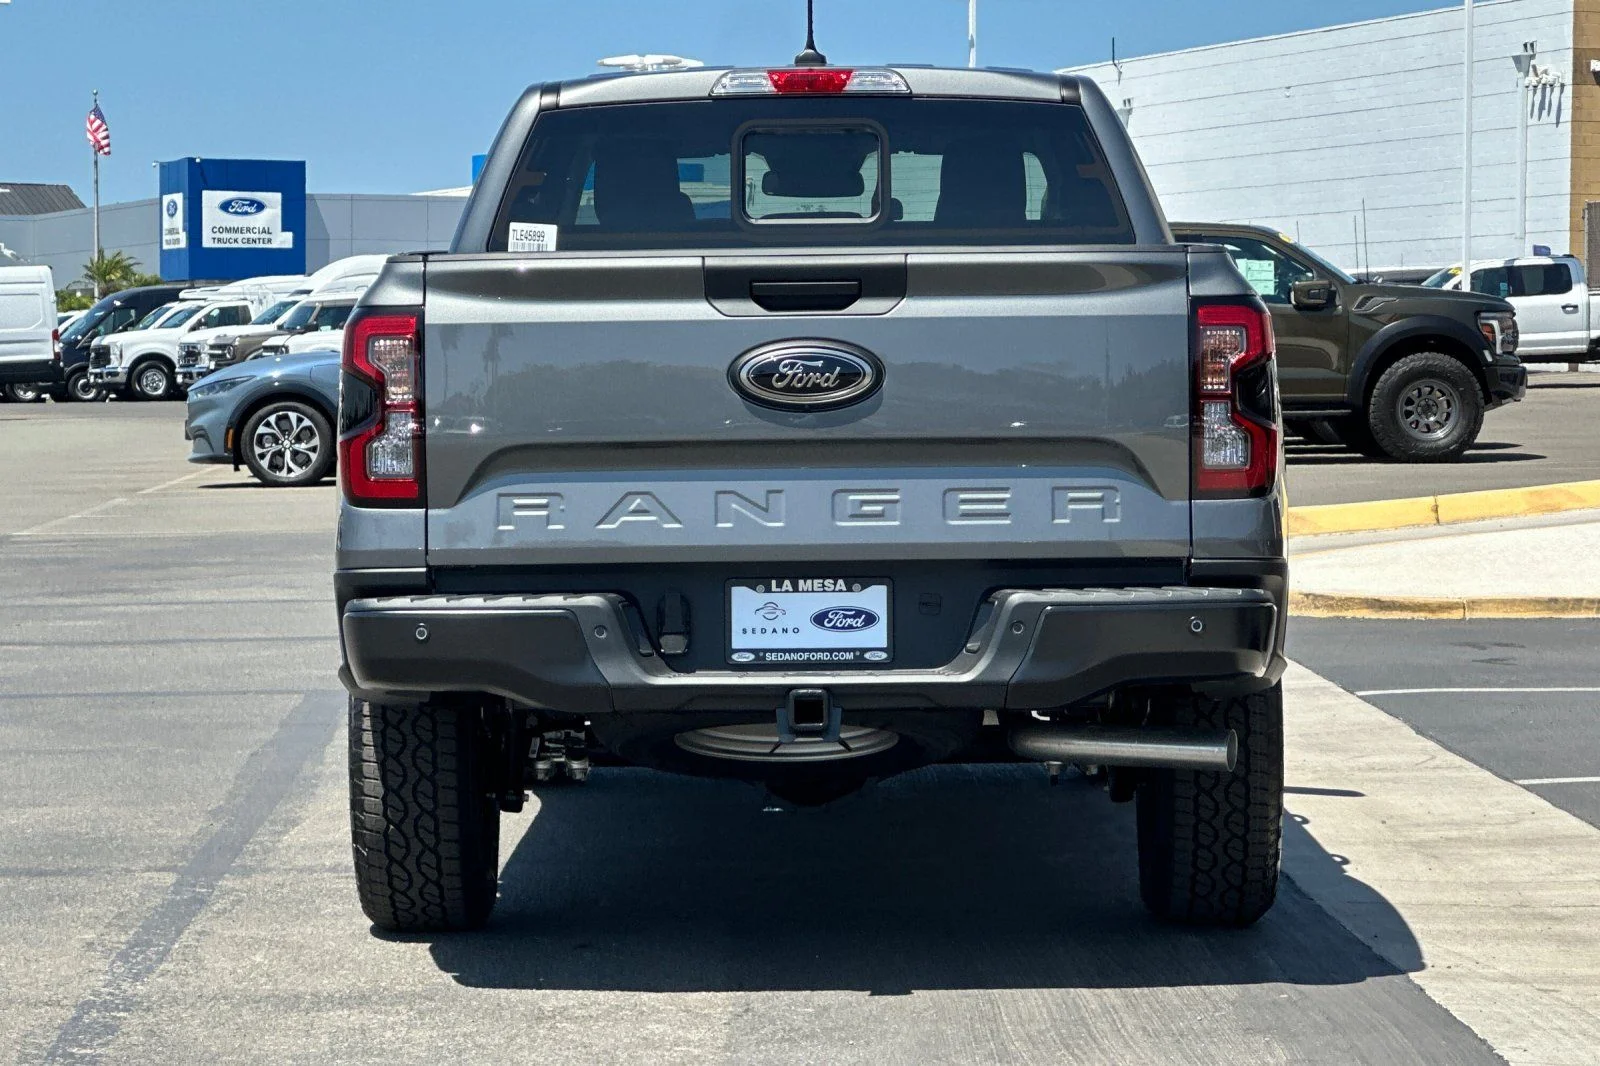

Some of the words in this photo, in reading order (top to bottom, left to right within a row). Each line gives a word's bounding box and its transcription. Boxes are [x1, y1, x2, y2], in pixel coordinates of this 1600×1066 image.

[228, 200, 257, 213] Ford
[211, 226, 273, 235] COMMERCIAL
[512, 229, 545, 242] TLE45899
[211, 237, 239, 245] TRUCK
[241, 237, 273, 245] CENTER
[771, 359, 841, 389] Ford
[496, 484, 1122, 531] RANGER
[771, 579, 793, 592] LA
[798, 579, 847, 592] MESA
[824, 610, 865, 628] Ford
[741, 627, 800, 635] SEDANO
[765, 652, 854, 661] SEDANOFORD.COM
